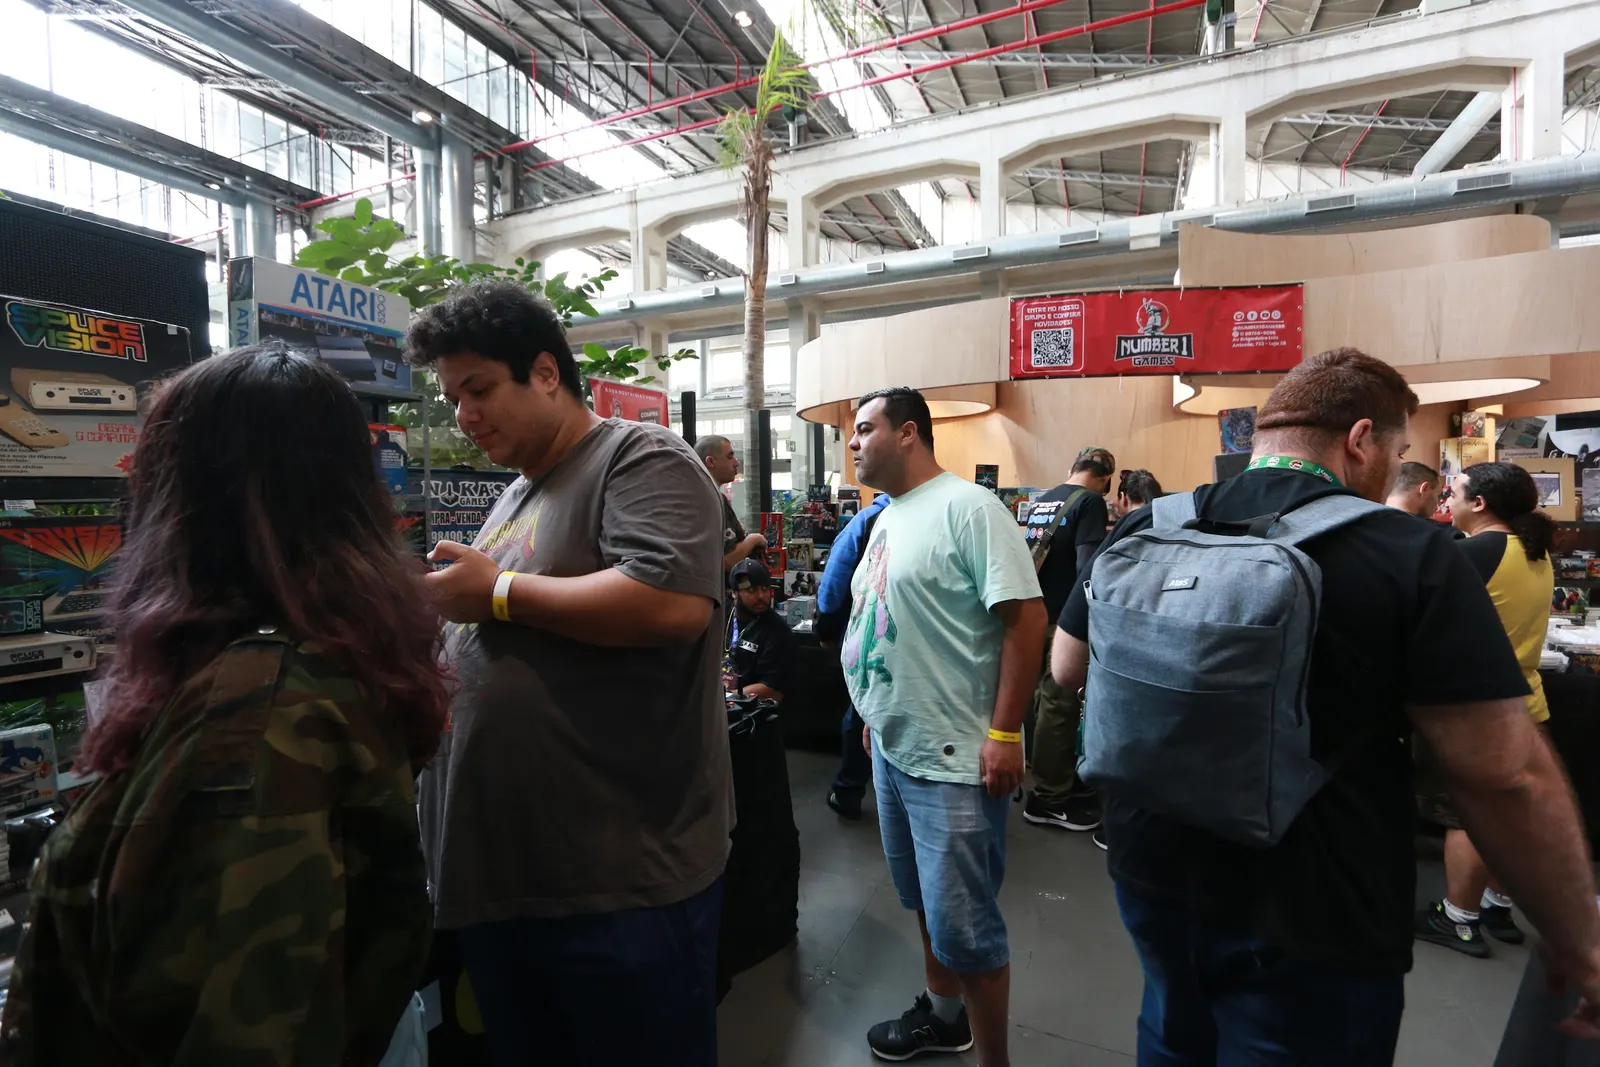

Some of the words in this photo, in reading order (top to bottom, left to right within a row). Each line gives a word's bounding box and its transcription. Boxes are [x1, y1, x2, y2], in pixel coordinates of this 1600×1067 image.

[291, 272, 376, 322] ATARI
[377, 294, 386, 324] 5200
[10, 303, 141, 342] SPLICE
[14, 324, 144, 359] VISION
[1121, 338, 1179, 356] NUMBER
[1182, 336, 1189, 355] 1
[1133, 356, 1174, 366] GAMES
[460, 498, 489, 507] GAMES
[26, 601, 34, 630] VISION
